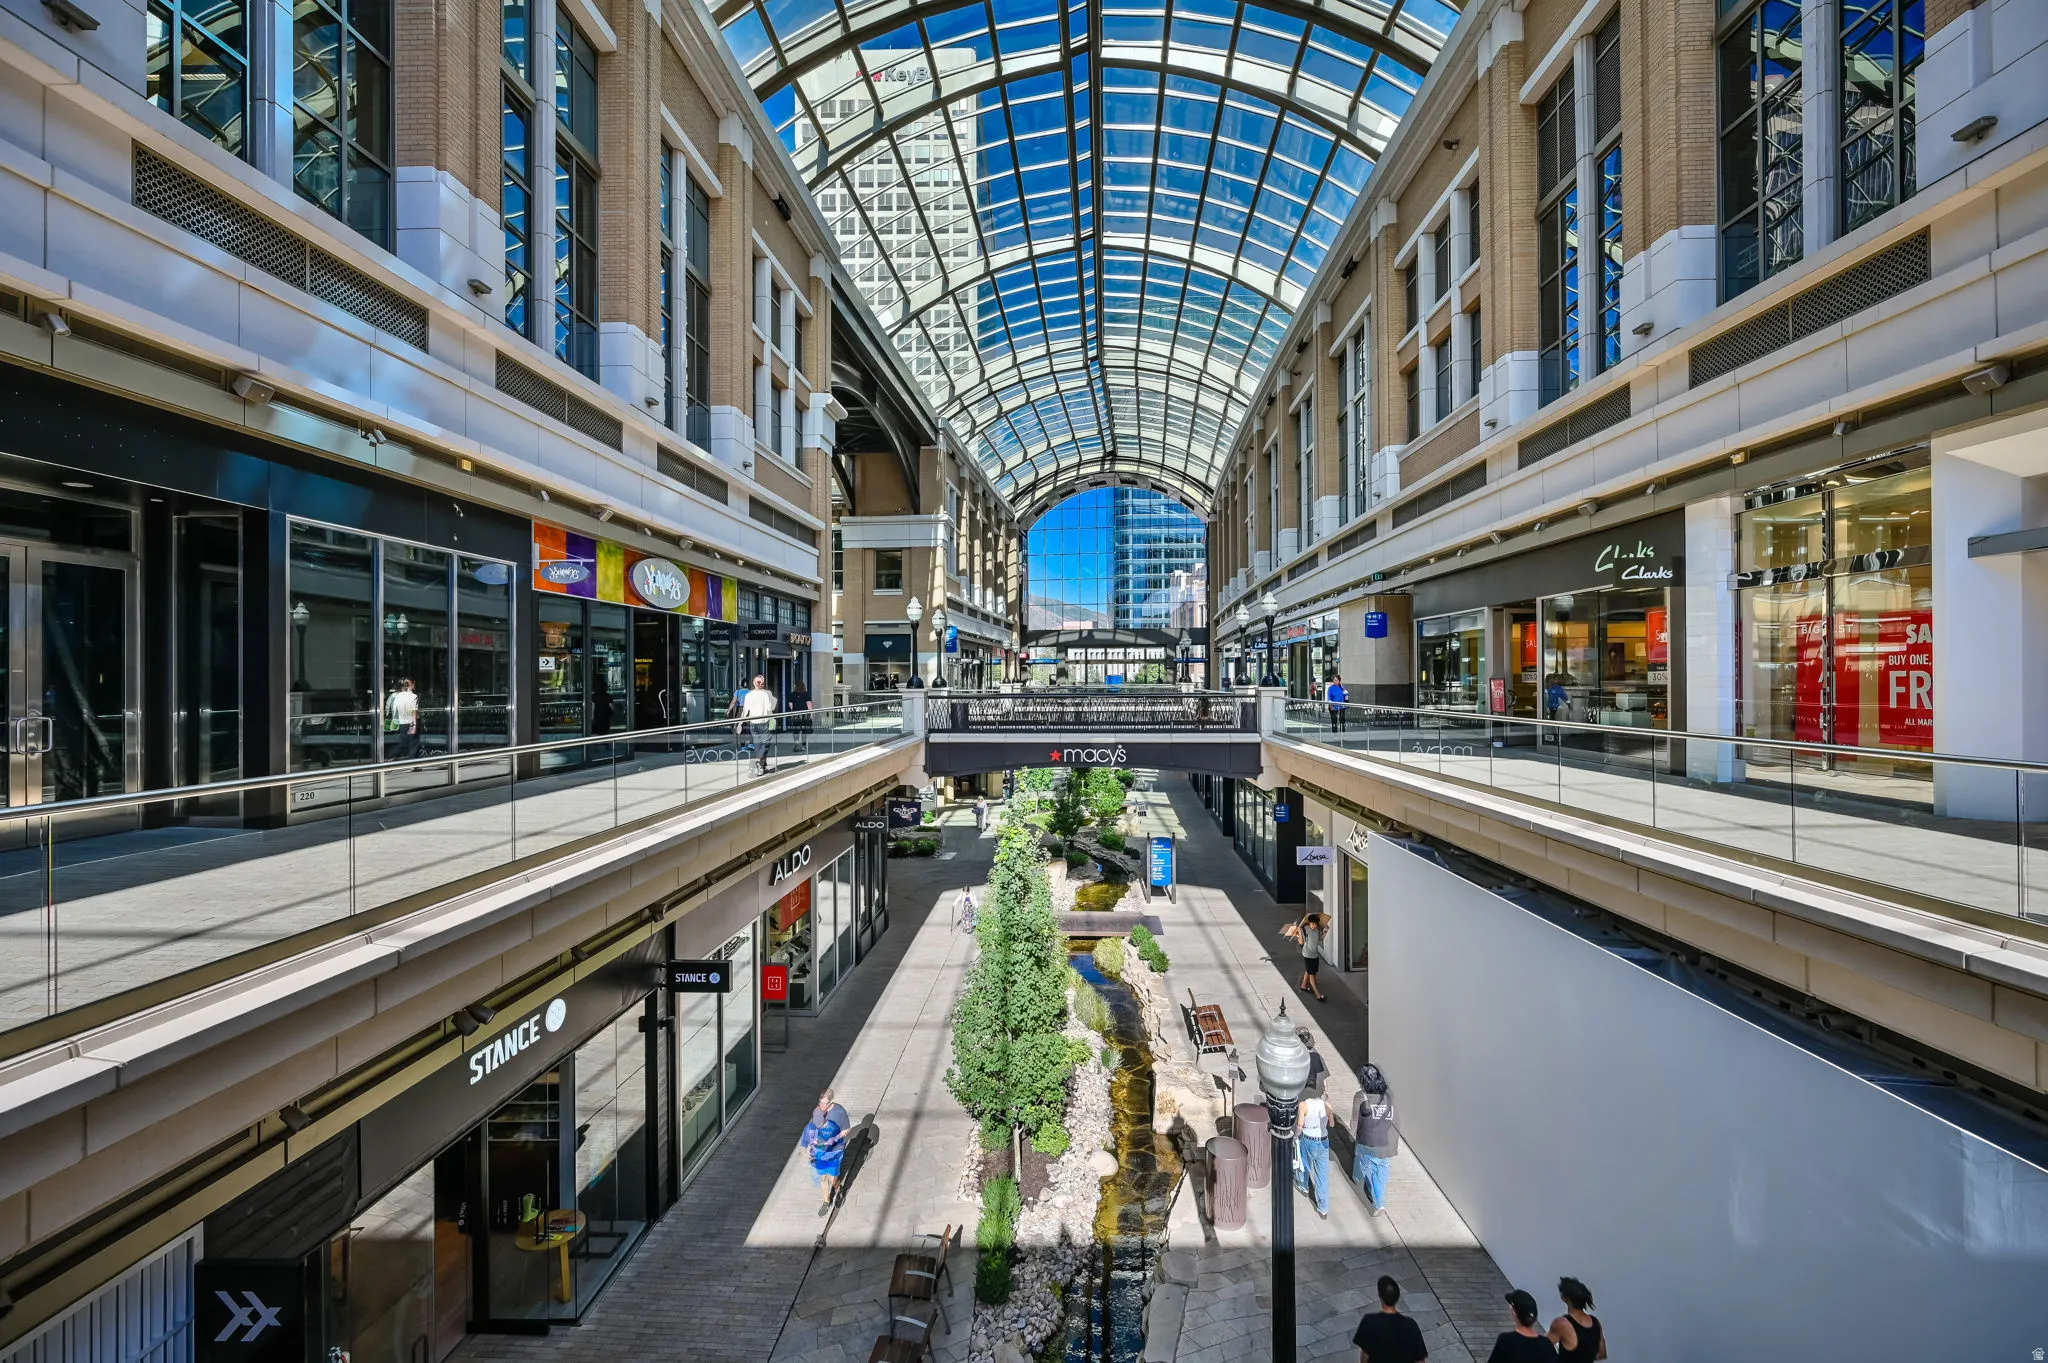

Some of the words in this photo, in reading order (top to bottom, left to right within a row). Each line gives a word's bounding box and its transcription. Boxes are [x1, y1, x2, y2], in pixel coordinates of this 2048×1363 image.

[1622, 565, 1673, 580] Clarks
[1888, 655, 1907, 666] BUY
[1909, 654, 1932, 666] ONE,
[1905, 718, 1916, 726] ALL
[1063, 744, 1127, 766] macy's
[300, 791, 315, 801] 220
[855, 821, 885, 829] ALDO
[773, 844, 811, 886] ALDO
[675, 973, 707, 983] STANCE
[469, 1013, 541, 1086] STANCE
